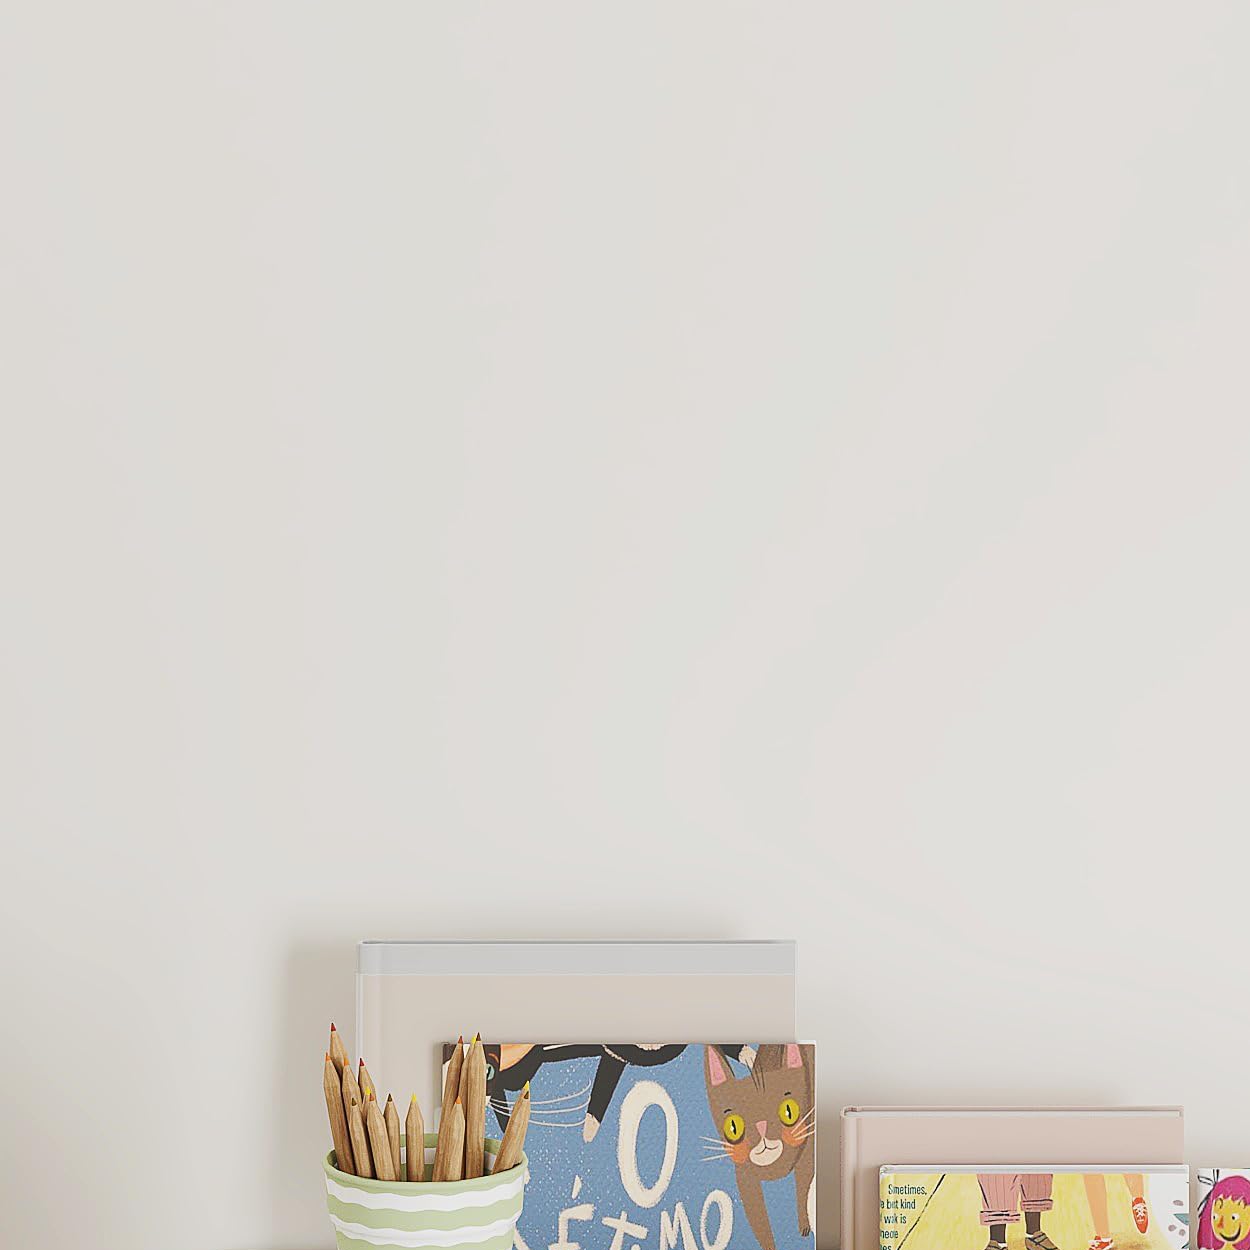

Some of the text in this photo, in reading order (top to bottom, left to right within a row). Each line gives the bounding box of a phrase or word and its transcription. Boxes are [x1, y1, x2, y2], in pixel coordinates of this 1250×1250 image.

[618, 1080, 678, 1208] O
[900, 1199, 916, 1209] kind
[900, 1213, 907, 1224] is
